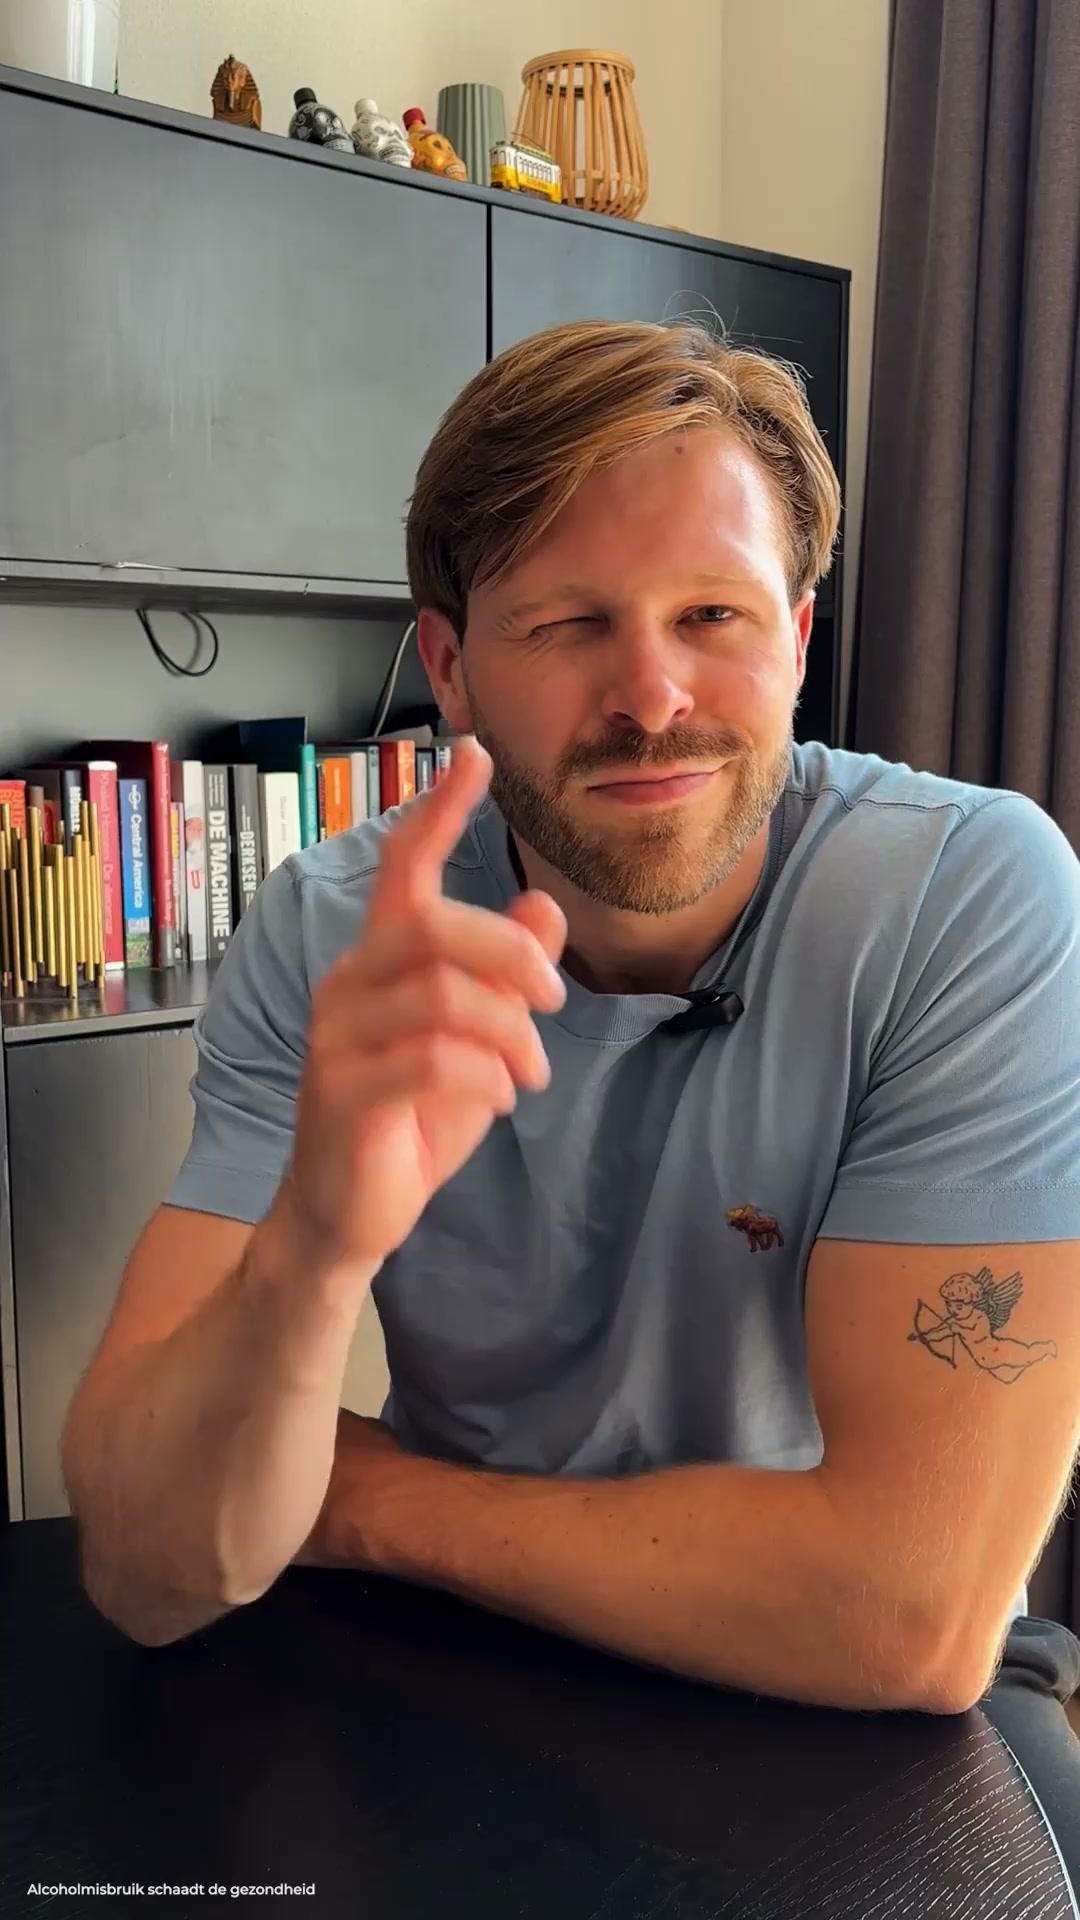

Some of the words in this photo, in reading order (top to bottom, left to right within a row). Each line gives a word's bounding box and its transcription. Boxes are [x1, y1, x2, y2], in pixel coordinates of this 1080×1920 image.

[131, 813, 144, 858] Central
[208, 810, 226, 840] DE
[132, 860, 144, 909] America
[240, 830, 257, 892] DERKSEN
[209, 842, 230, 938] MACHINE
